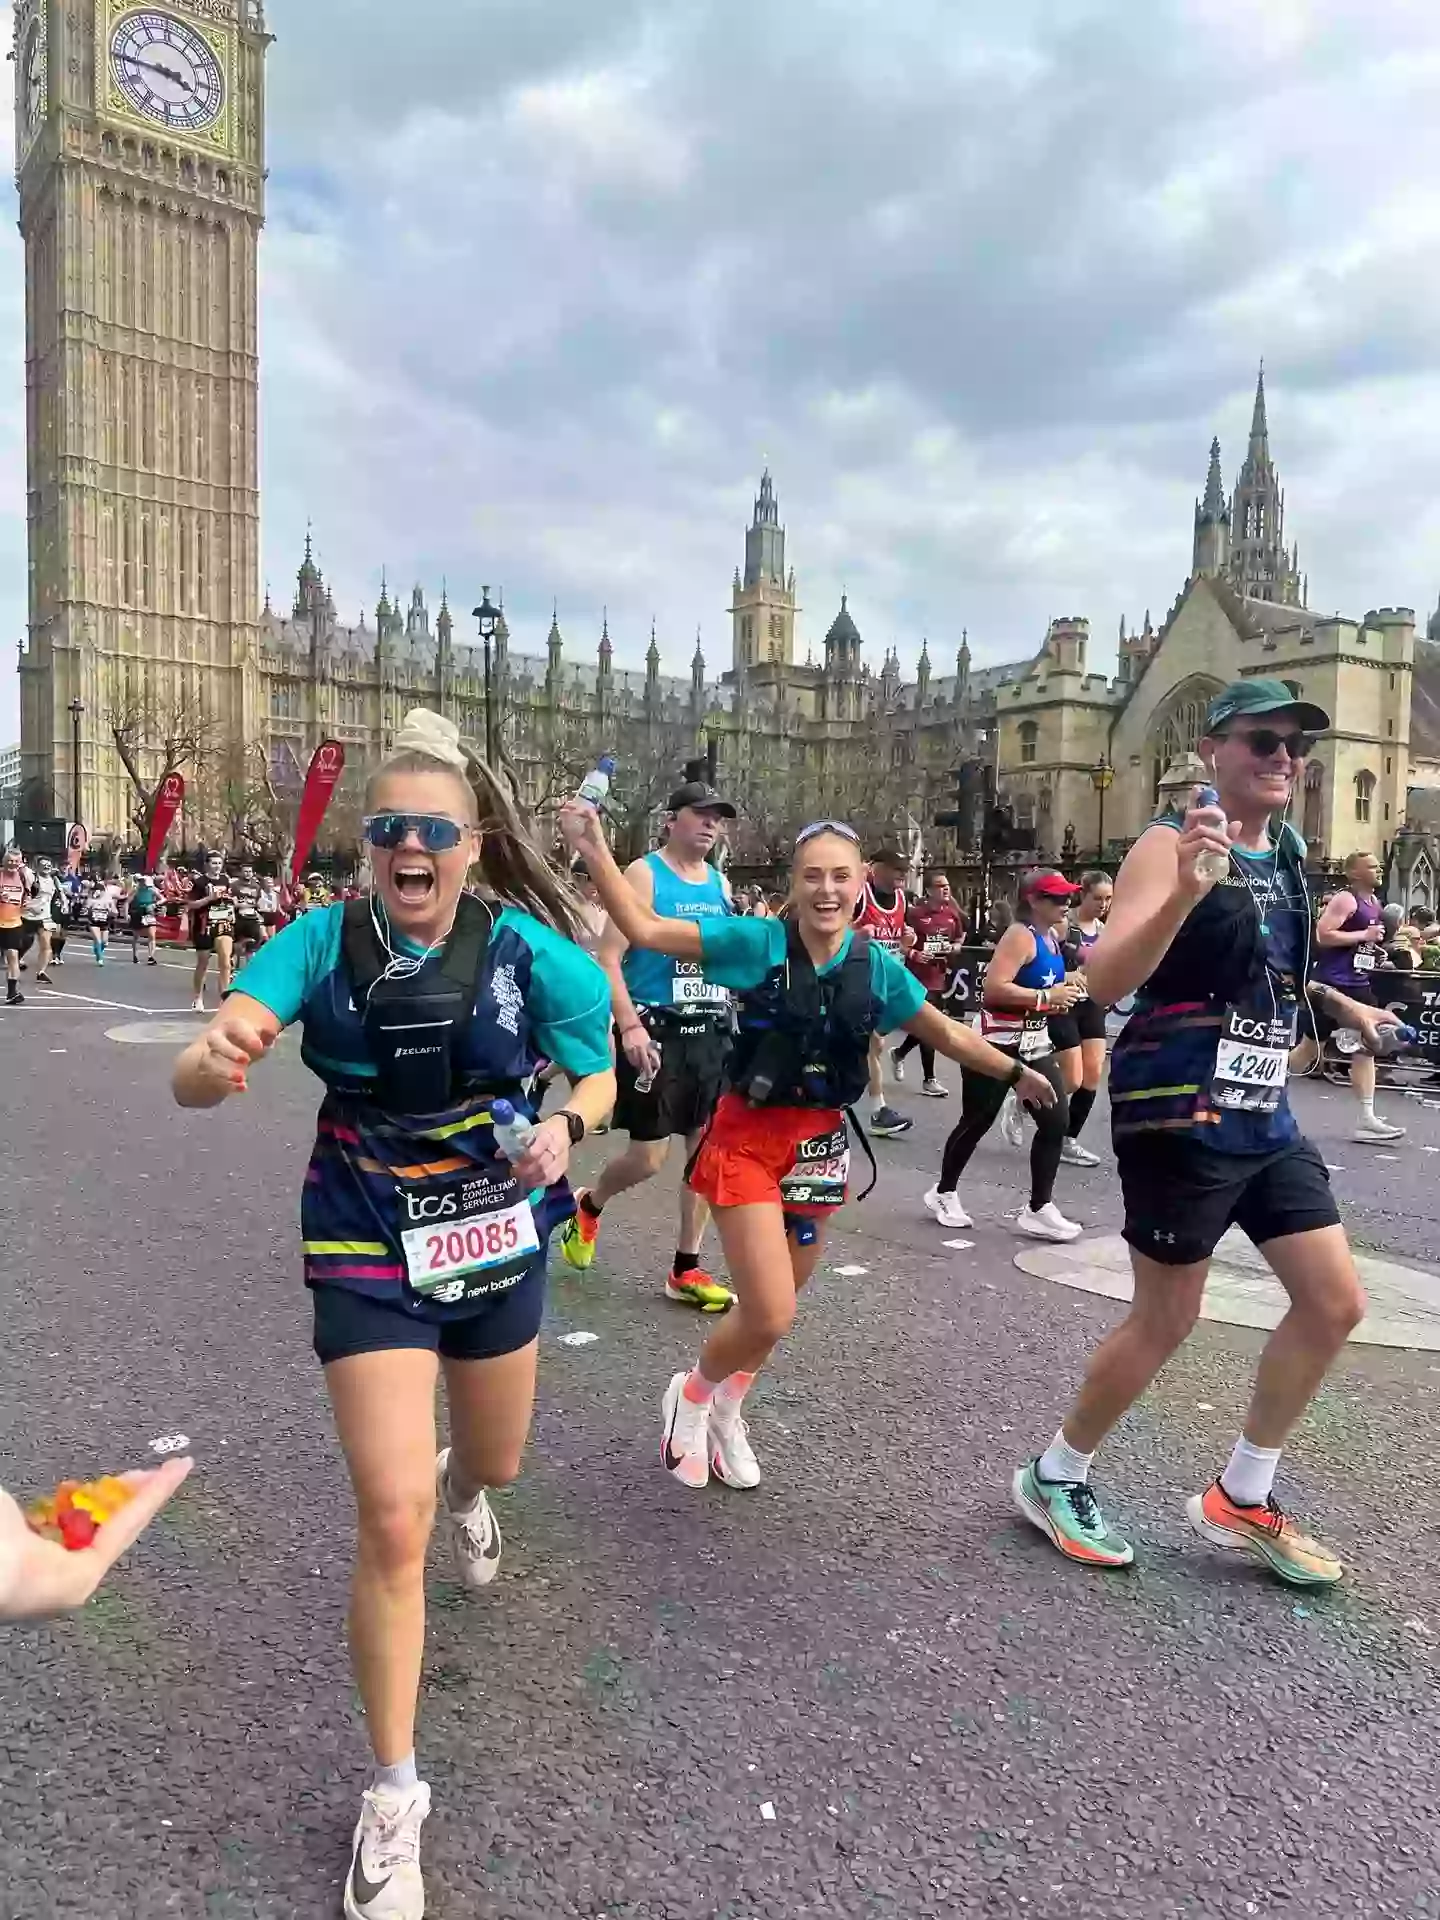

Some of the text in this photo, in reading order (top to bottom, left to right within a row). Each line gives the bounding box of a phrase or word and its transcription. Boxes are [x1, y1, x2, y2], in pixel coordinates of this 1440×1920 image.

[675, 960, 698, 975] tcs
[680, 1024, 706, 1035] nerd
[1230, 1011, 1267, 1040] tcs
[402, 1046, 442, 1055] ZELAFIT
[461, 1177, 490, 1192] TATA
[406, 1192, 457, 1220] tcs
[463, 1192, 505, 1211] SERVICES
[426, 1216, 518, 1270] 20085
[467, 1284, 489, 1299] new
